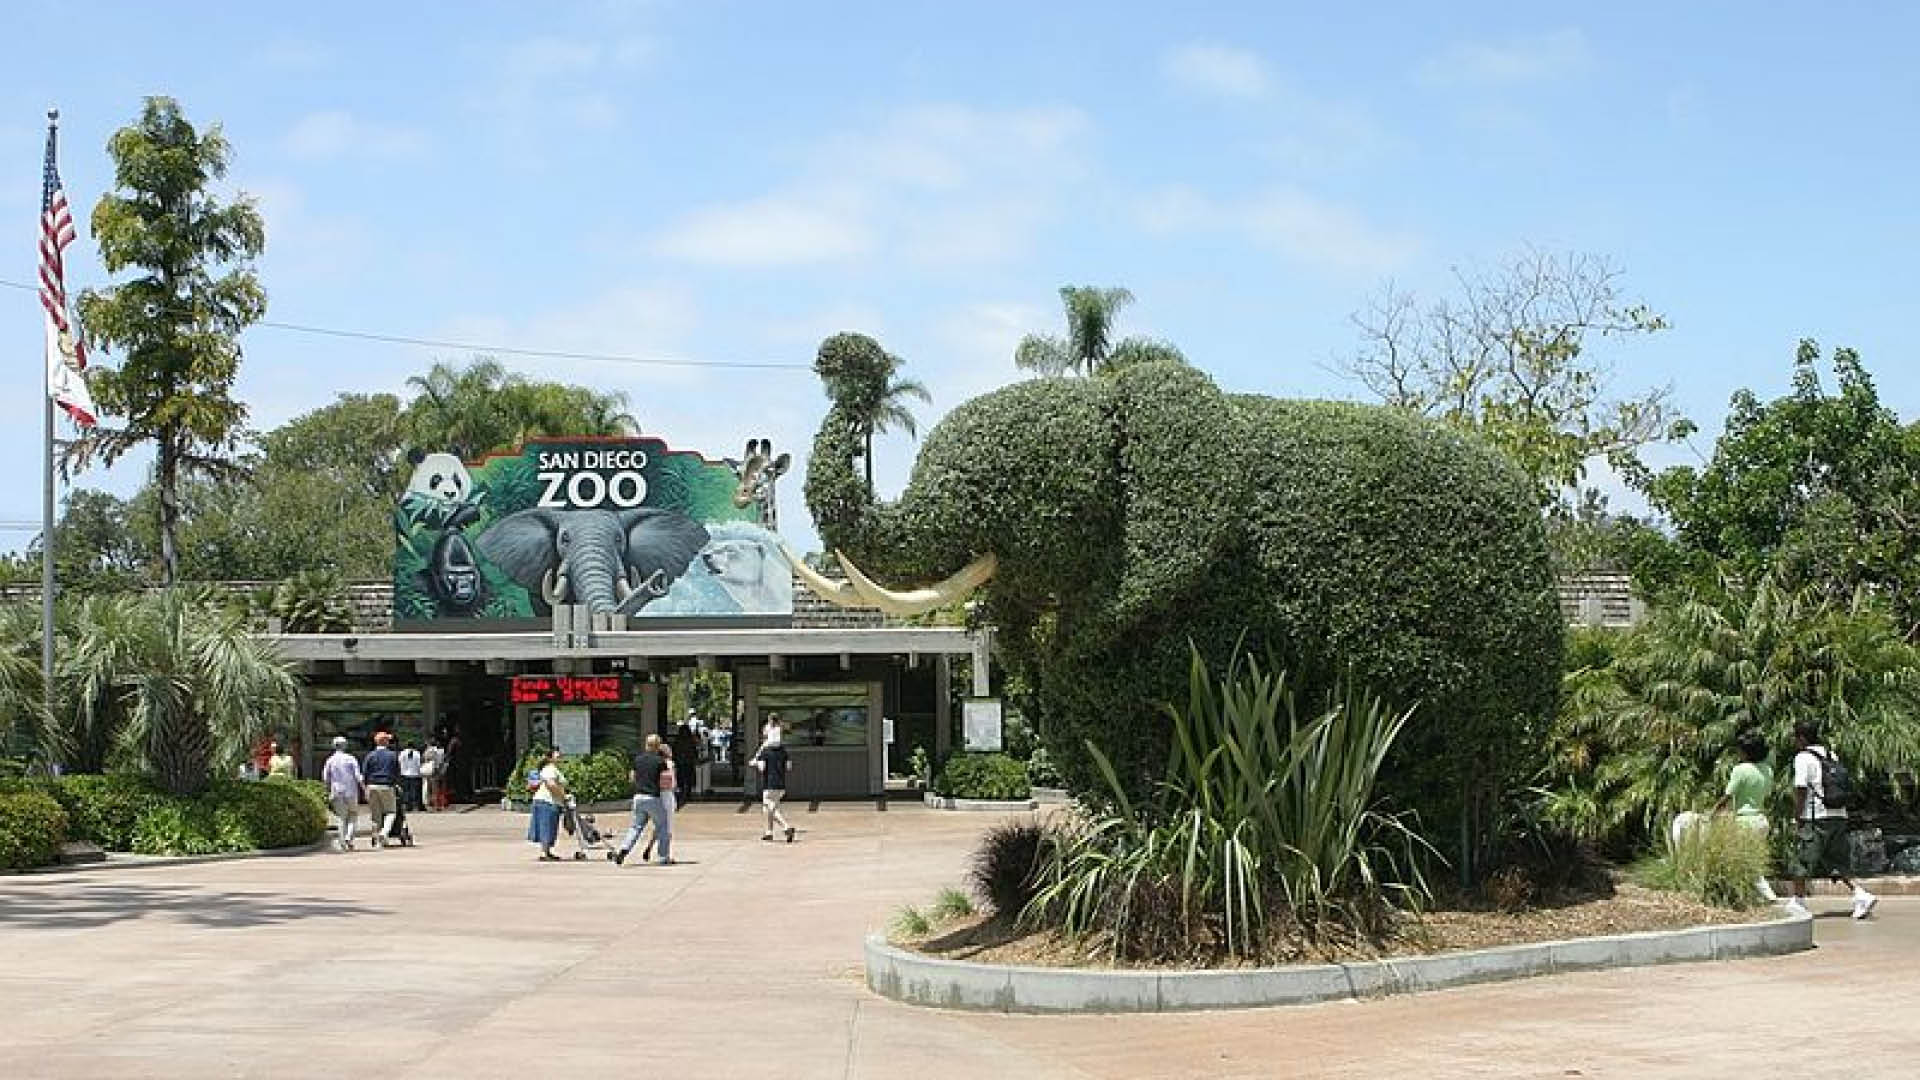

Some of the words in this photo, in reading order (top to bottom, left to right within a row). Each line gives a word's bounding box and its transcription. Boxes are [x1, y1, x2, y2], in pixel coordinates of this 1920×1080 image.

[539, 452, 580, 469] SAN
[585, 451, 648, 469] DIEGO
[537, 471, 647, 507] ZOO
